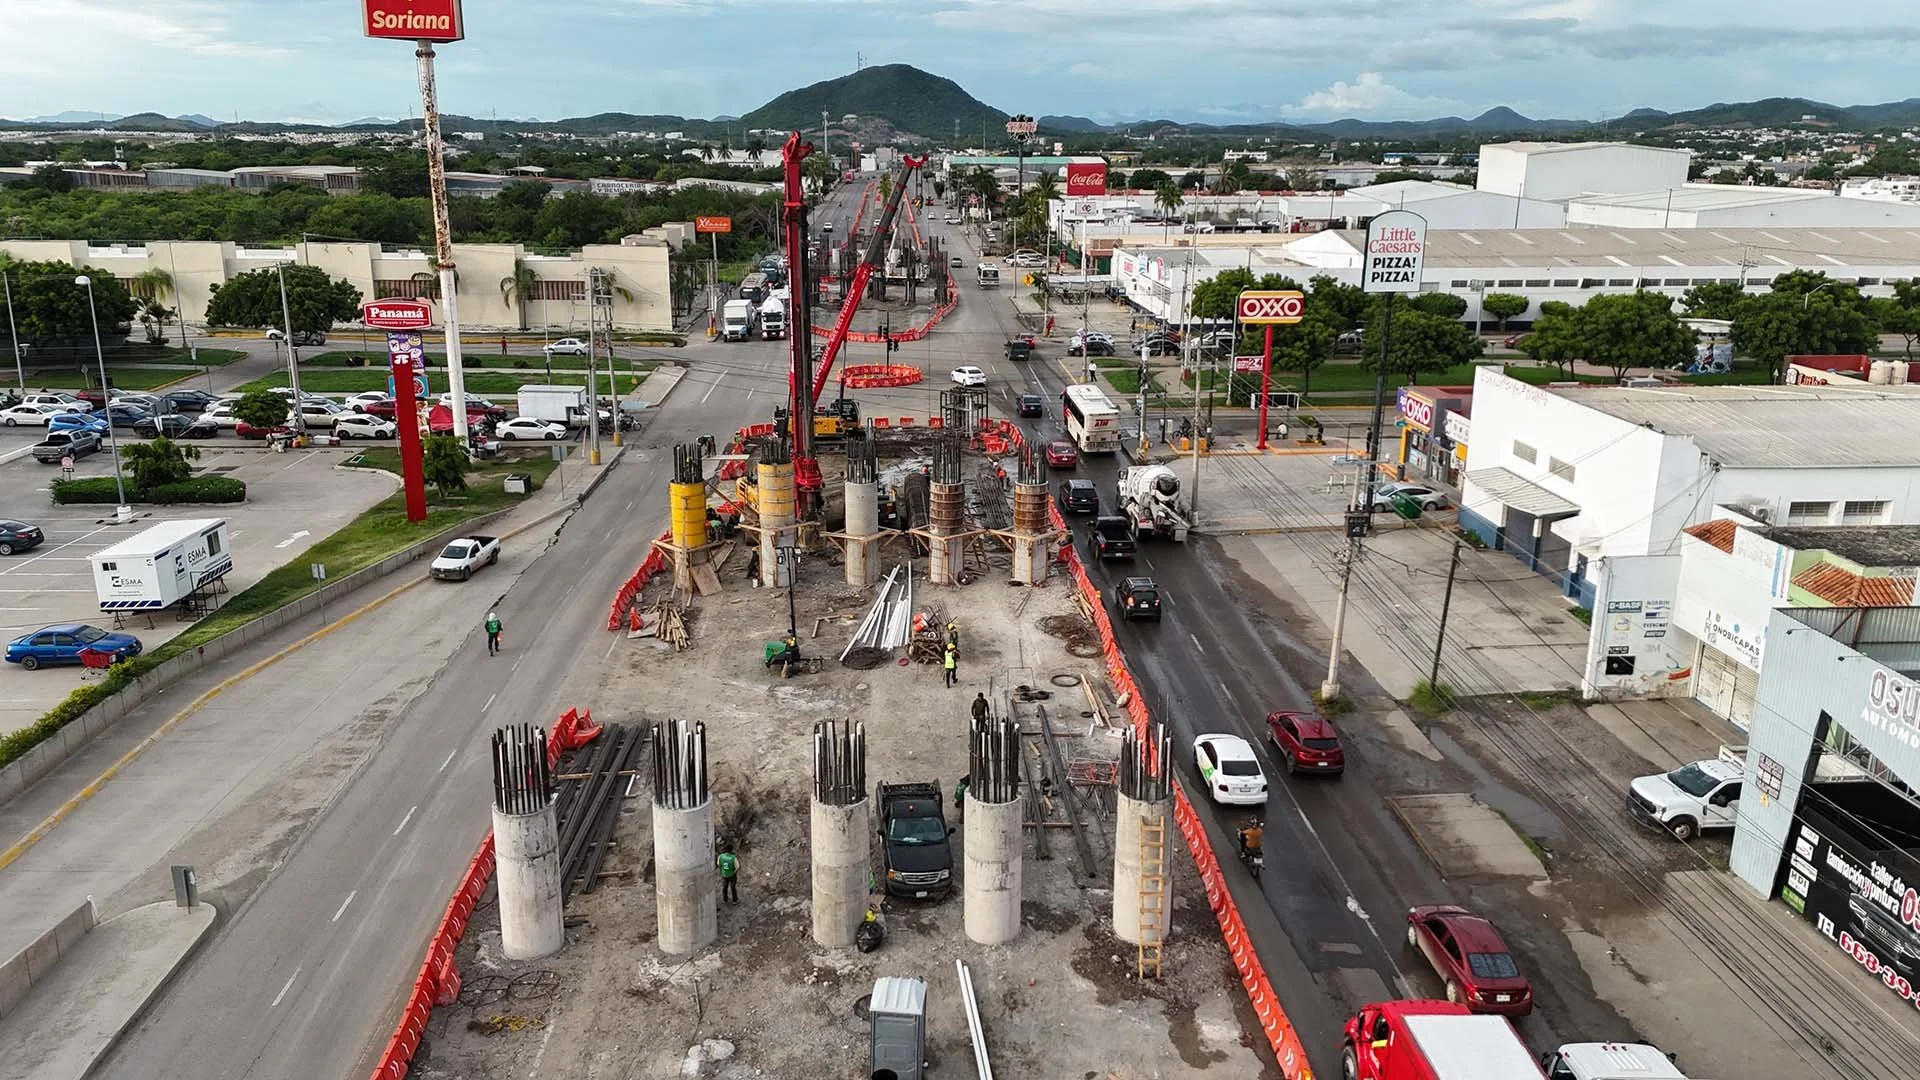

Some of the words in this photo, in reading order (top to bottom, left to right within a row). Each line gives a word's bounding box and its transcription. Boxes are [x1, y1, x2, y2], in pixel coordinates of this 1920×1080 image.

[372, 10, 449, 29] Soriana
[1380, 227, 1416, 241] Little
[1369, 240, 1421, 253] Caesars
[1373, 257, 1416, 268] PIZZA!
[1371, 271, 1415, 283] PIZZA!
[369, 307, 424, 319] Panamá
[1243, 298, 1301, 318] OXXO
[1406, 398, 1431, 425] OXXO
[188, 546, 207, 563] ESMA
[1790, 870, 1807, 888] HDI
[1826, 845, 1864, 889] laminación
[1869, 881, 1900, 916] pintura
[1870, 860, 1894, 889] taller
[1892, 877, 1905, 897] de
[1817, 912, 1838, 943] TEL.
